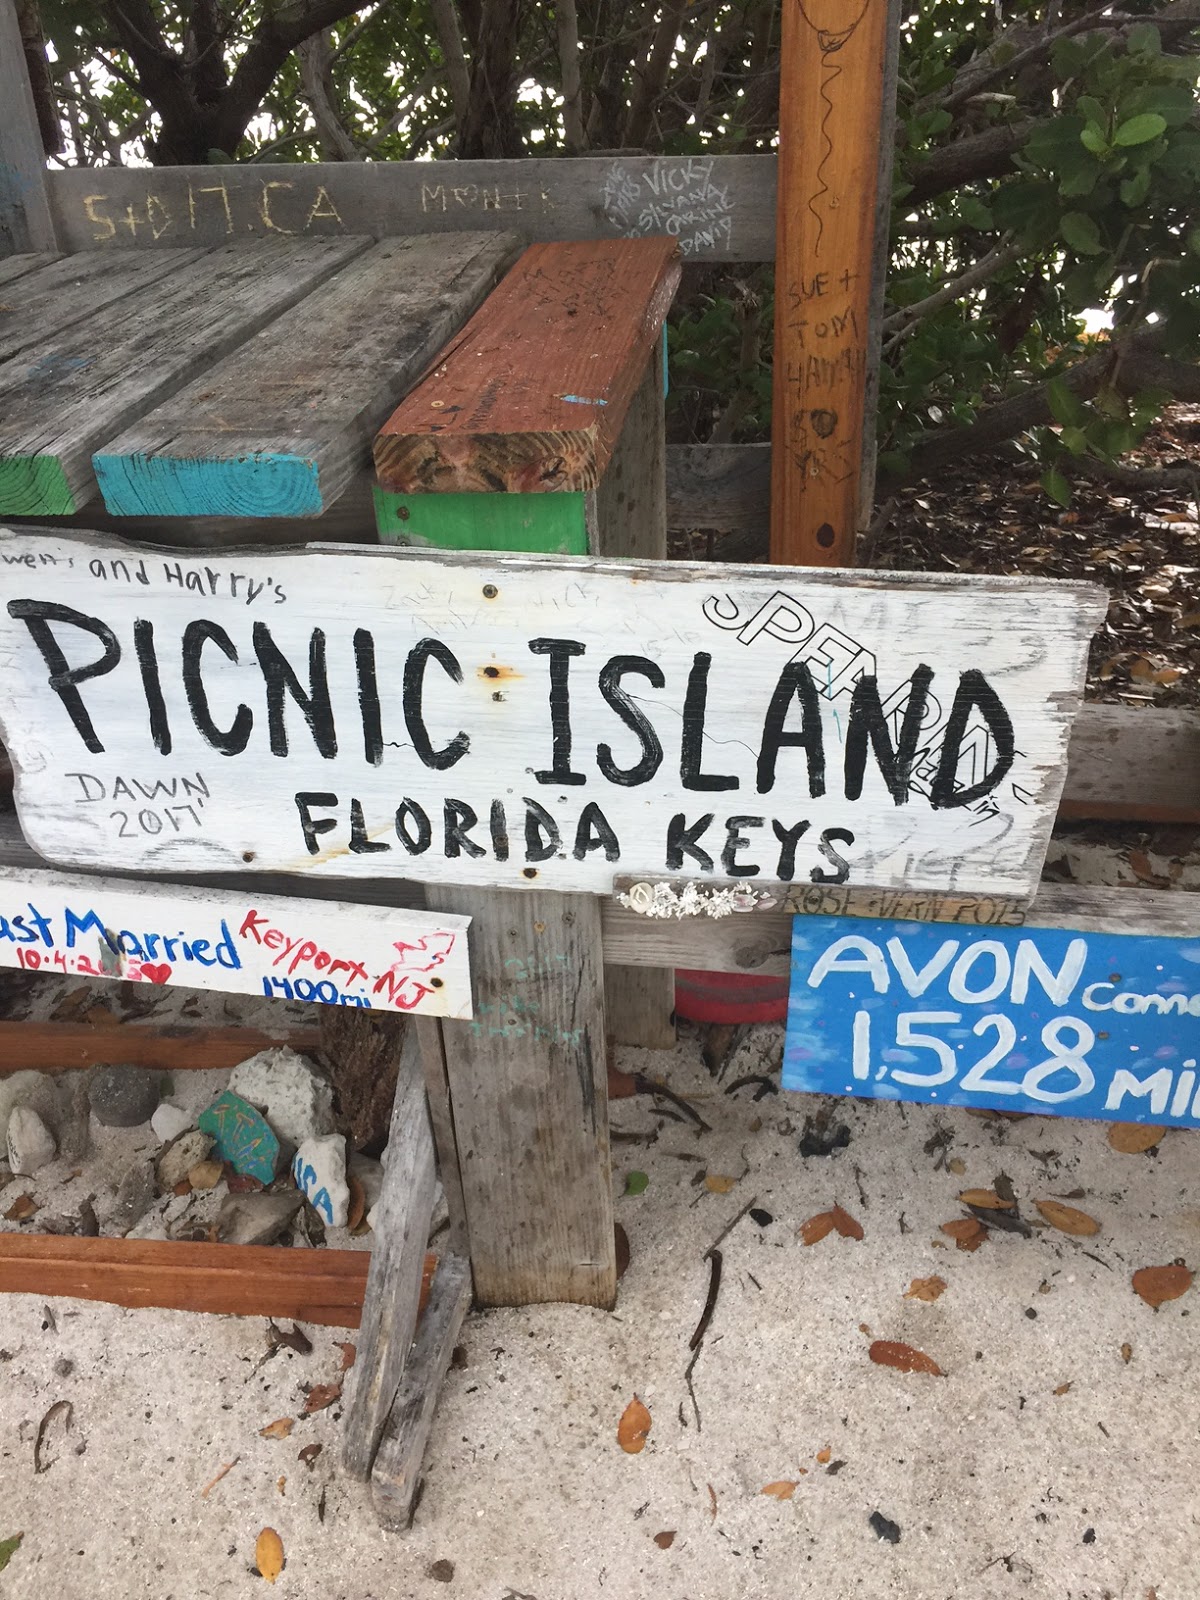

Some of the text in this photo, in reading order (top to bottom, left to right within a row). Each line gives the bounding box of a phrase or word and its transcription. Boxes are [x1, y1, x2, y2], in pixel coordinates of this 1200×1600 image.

[642, 158, 714, 200] VICKY
[787, 272, 830, 309] SUE
[787, 305, 860, 349] TOM
[88, 558, 151, 586] and
[162, 562, 288, 606] Harry's
[7, 598, 471, 771] PICNIC
[528, 637, 1016, 810] ISLAND
[64, 771, 211, 803] DAWN
[295, 792, 856, 884] FLORIDA KEYS
[65, 906, 243, 970] Married
[806, 934, 1088, 1007] AVON
[853, 1010, 1096, 1103] 1,528
